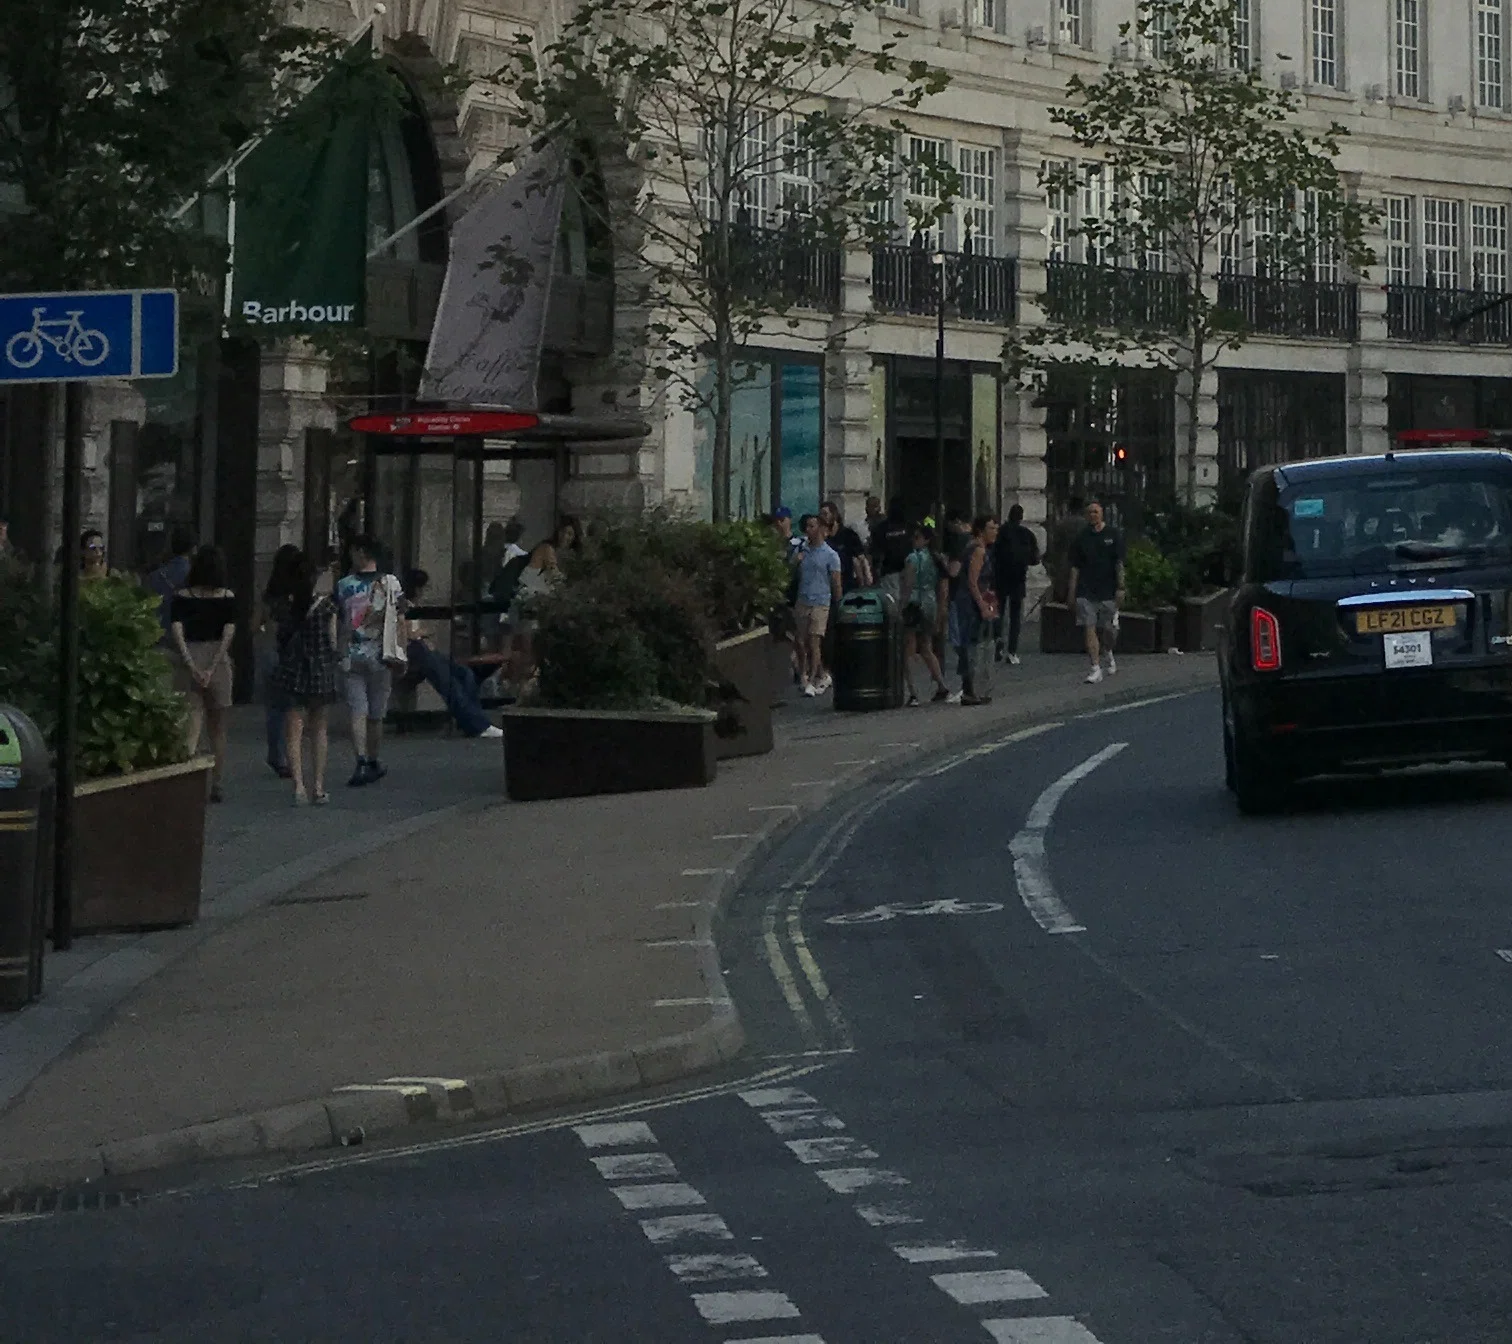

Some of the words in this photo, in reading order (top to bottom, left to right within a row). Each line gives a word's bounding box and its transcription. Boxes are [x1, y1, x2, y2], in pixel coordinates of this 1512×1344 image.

[242, 299, 355, 324] Barbour
[1366, 611, 1405, 630] LF21
[1410, 609, 1444, 626] CGZ
